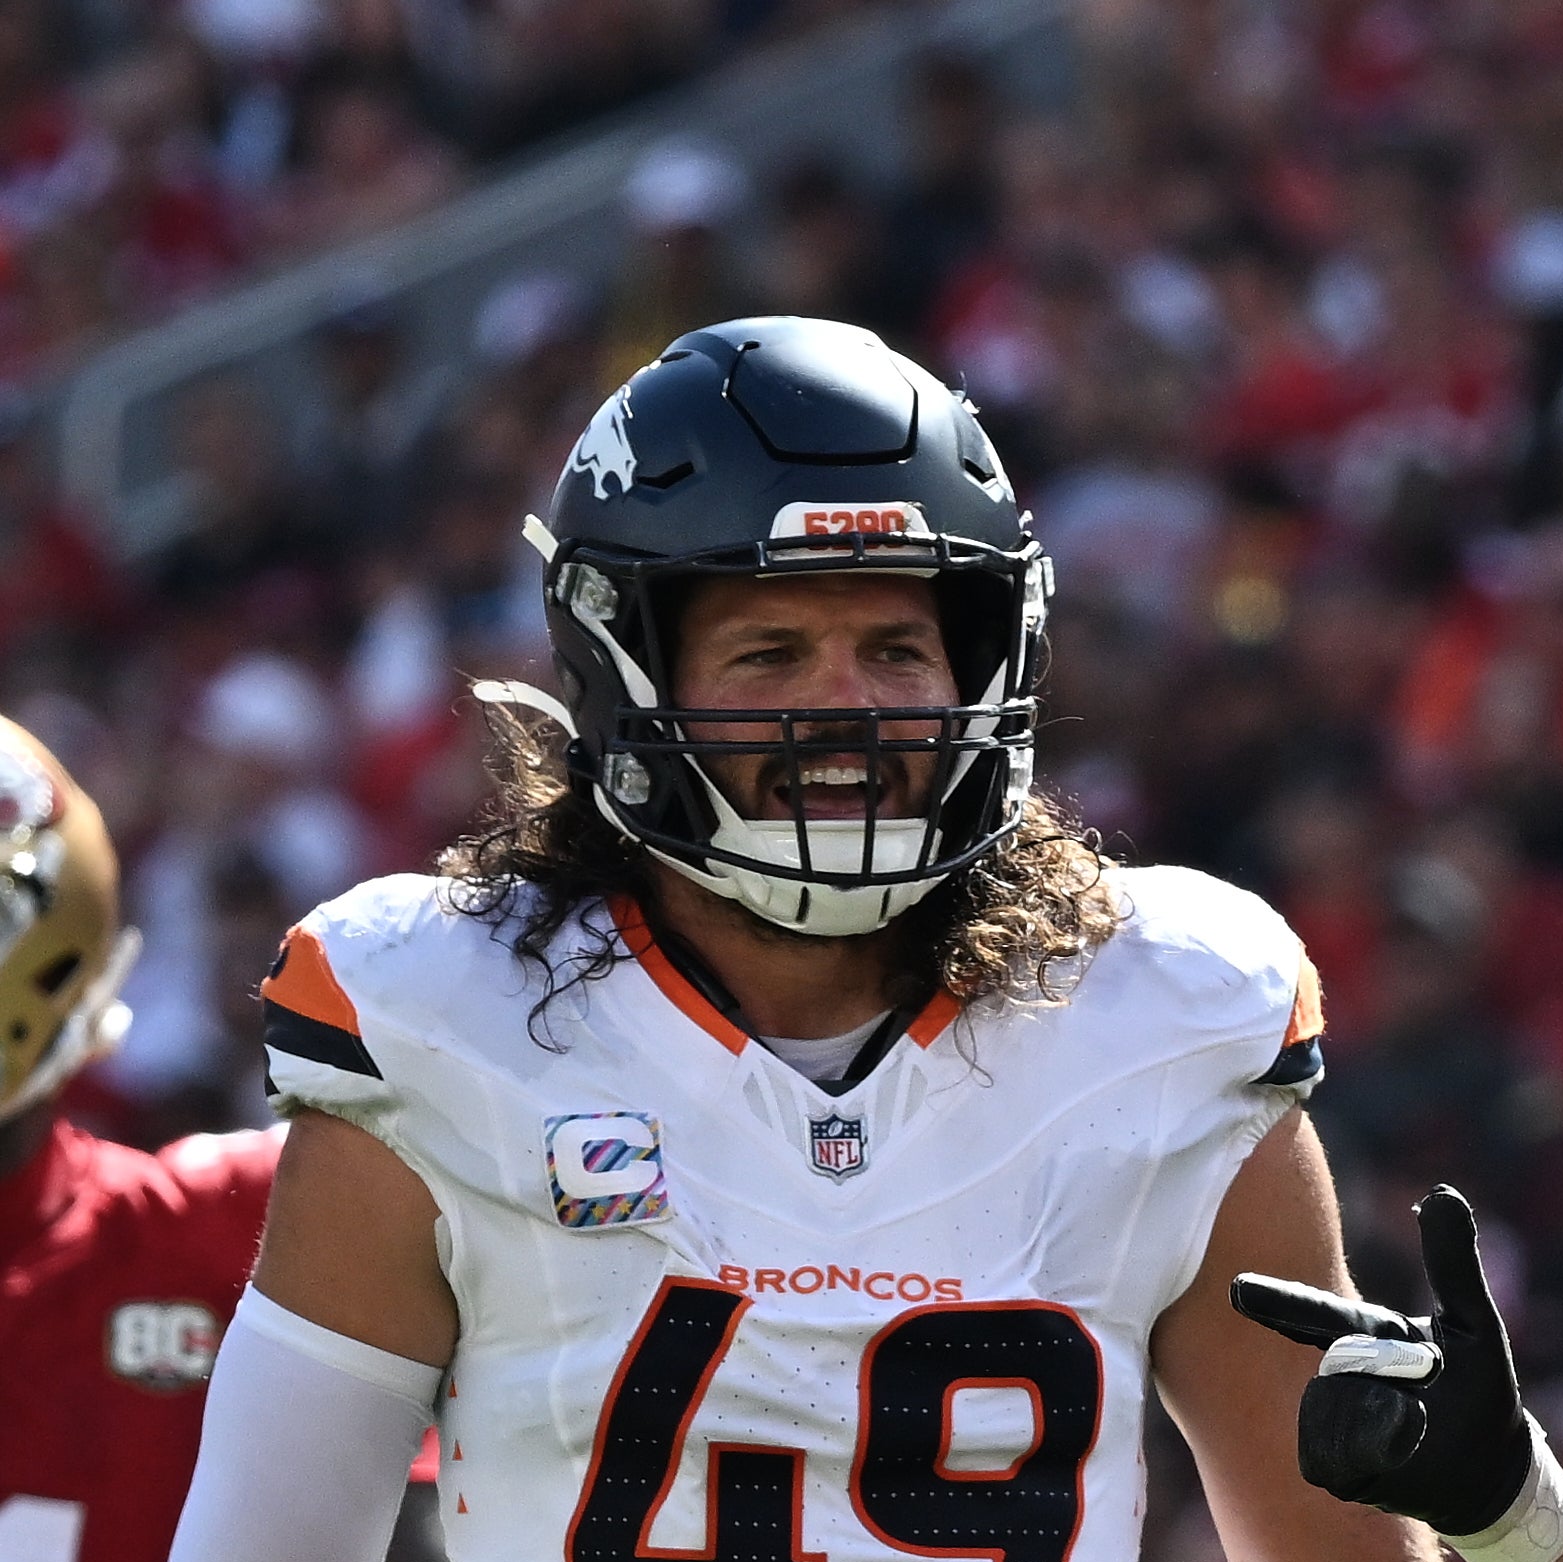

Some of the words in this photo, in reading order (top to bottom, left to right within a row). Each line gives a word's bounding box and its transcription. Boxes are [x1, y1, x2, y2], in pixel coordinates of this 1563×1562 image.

[552, 1118, 659, 1199] C
[817, 1140, 859, 1168] NFL
[719, 1263, 964, 1302] BRONCOS
